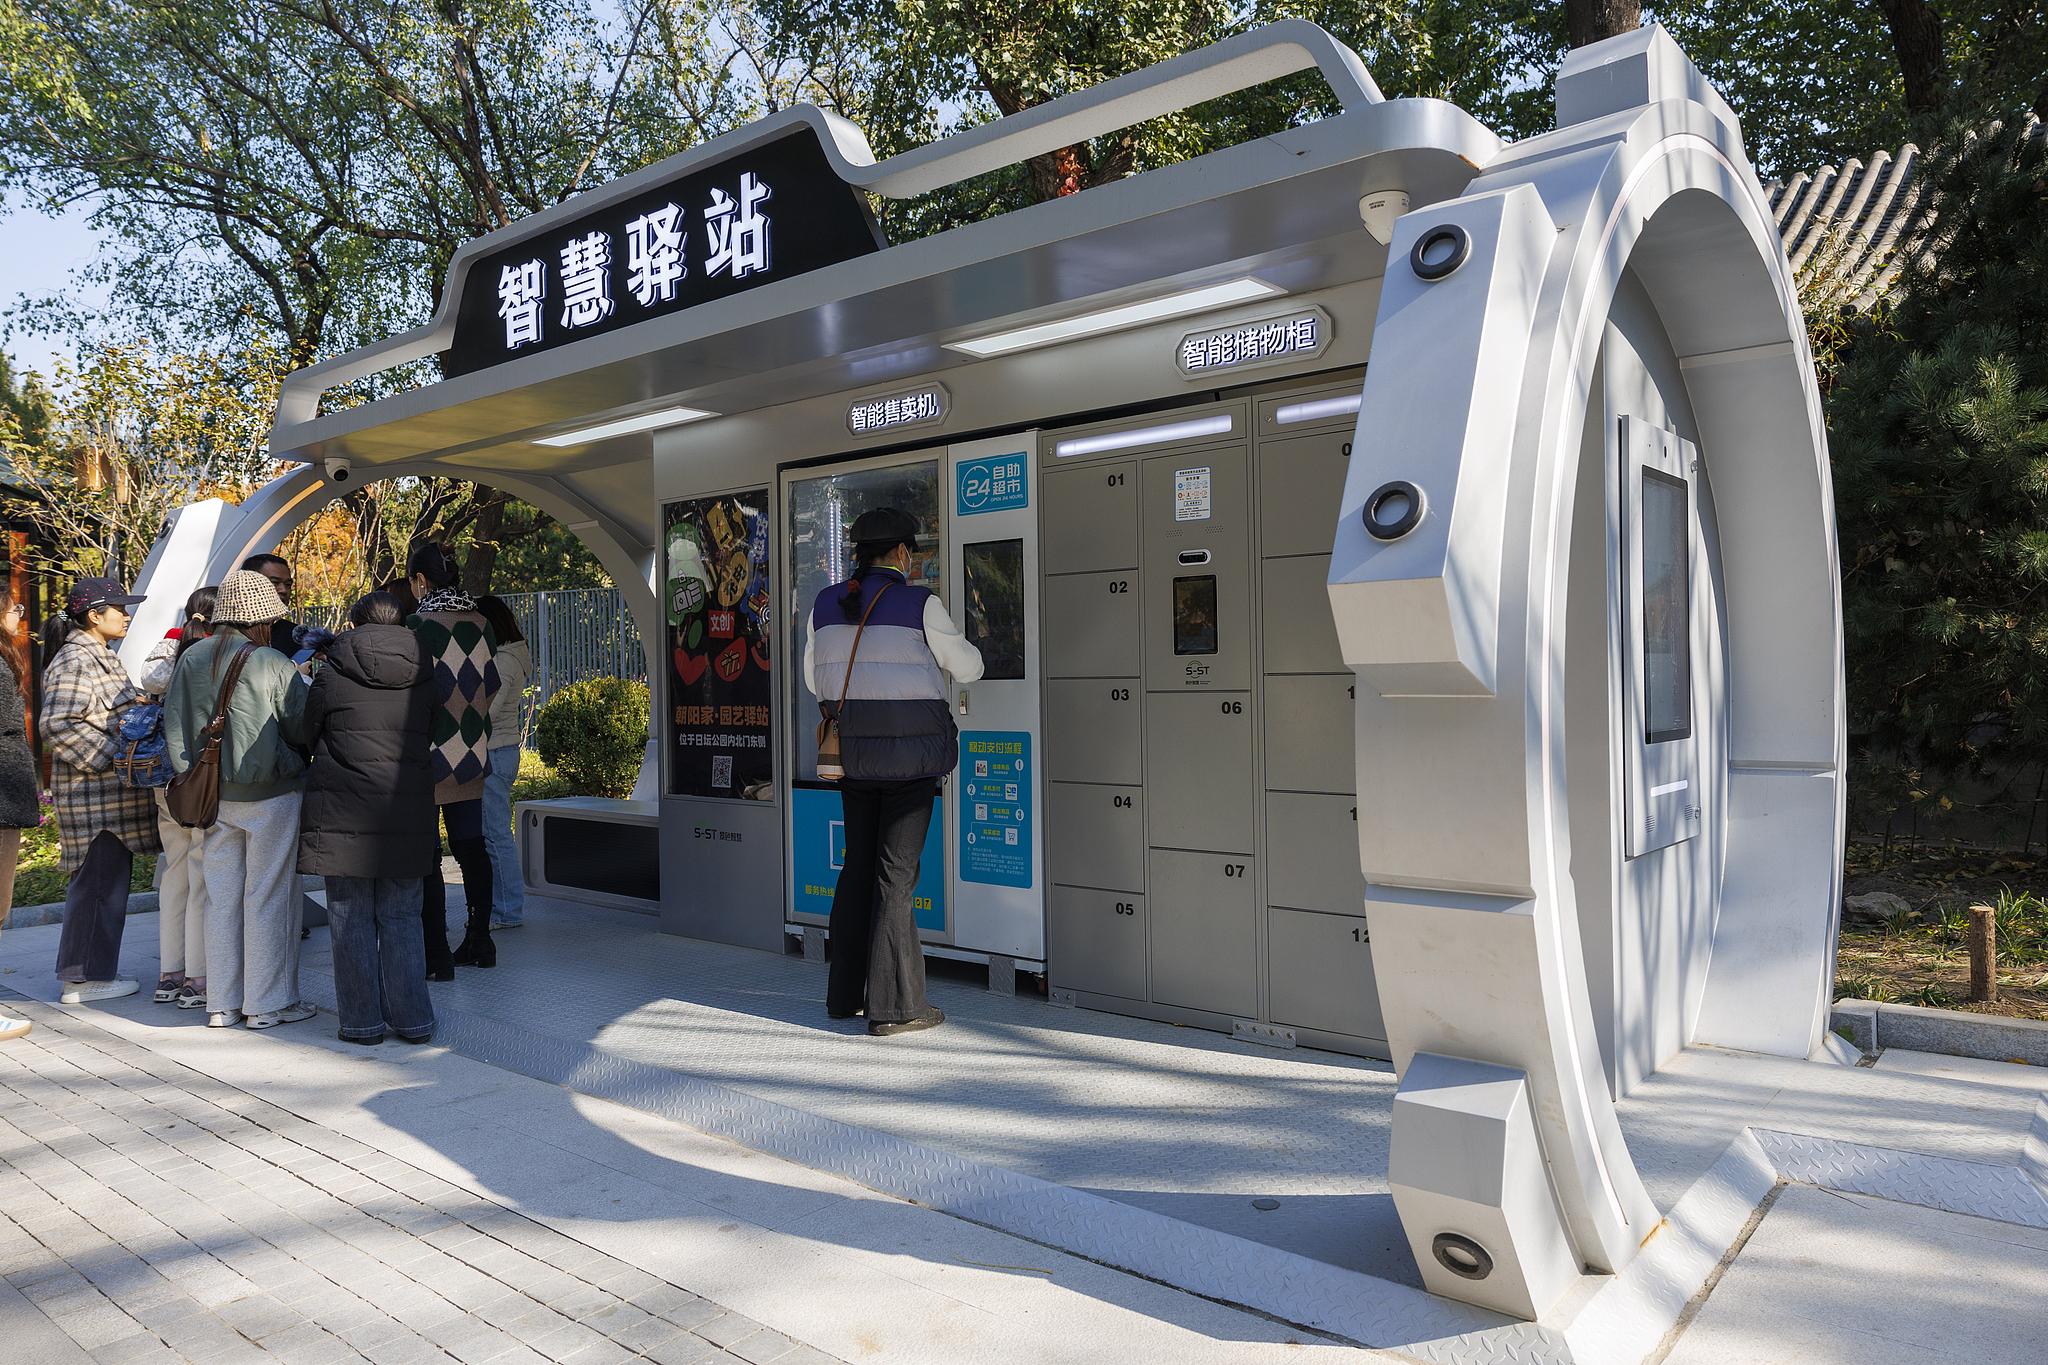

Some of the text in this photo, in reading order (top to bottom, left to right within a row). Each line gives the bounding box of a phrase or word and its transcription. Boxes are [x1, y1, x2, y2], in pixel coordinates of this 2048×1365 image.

[498, 171, 772, 350] 智慧驿站
[1183, 318, 1317, 369] 智能储物柜
[851, 393, 939, 430] 智能售卖机
[992, 462, 1021, 480] 自助
[1107, 473, 1124, 487] 01
[966, 478, 991, 497] 24
[992, 479, 1021, 496] 超市
[1109, 580, 1127, 594] 02
[710, 613, 731, 632] 文创
[1185, 665, 1210, 676] S-ST
[1111, 688, 1129, 701] 03
[1221, 701, 1243, 715] 06
[674, 705, 769, 727] 朝阳家·园艺驿站
[679, 733, 767, 748] 位于日坛公园内北门东侧
[968, 741, 1022, 755] 移动支付流程
[1113, 795, 1132, 809] 04
[694, 827, 718, 840] S-ST
[1224, 863, 1245, 878] 07
[805, 884, 835, 898] 服务热线
[1115, 902, 1134, 916] 05
